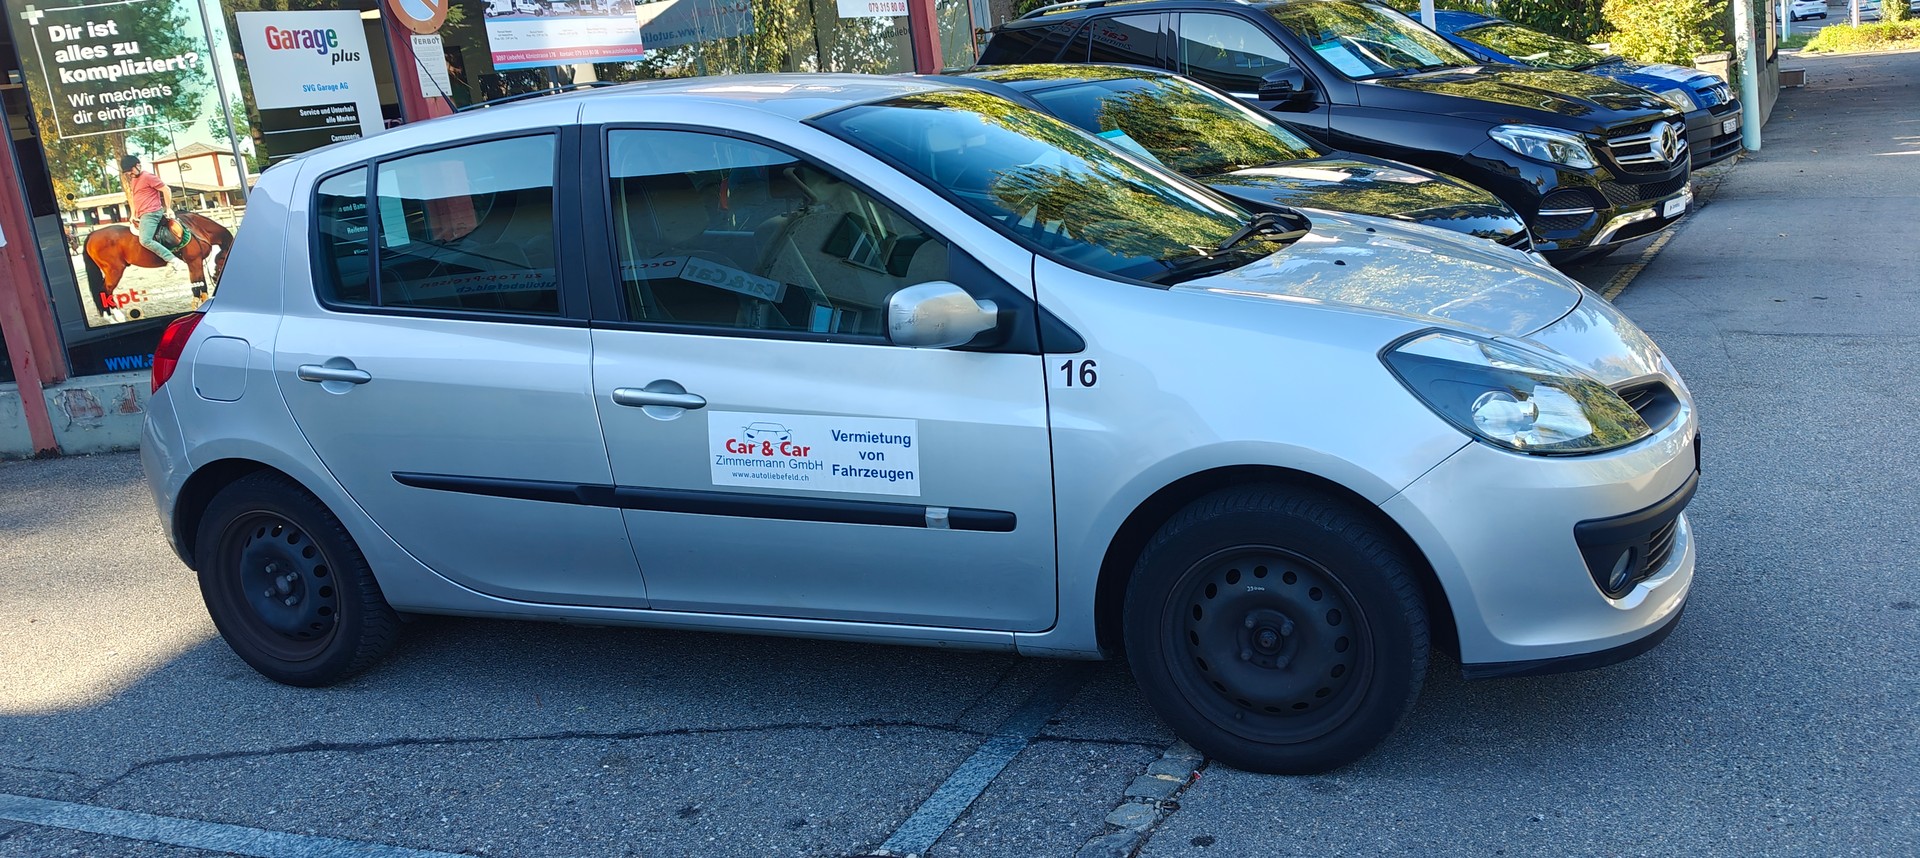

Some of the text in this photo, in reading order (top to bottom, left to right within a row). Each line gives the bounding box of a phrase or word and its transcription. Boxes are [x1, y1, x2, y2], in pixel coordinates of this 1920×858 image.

[868, 3, 879, 12] 079
[880, 2, 890, 12] 315
[48, 20, 119, 42] Dir ist
[265, 25, 338, 55] Garage
[413, 37, 440, 45] VERBOT
[54, 41, 140, 63] alles zu
[332, 49, 360, 65] plus
[59, 52, 199, 83] kompliziert?
[302, 82, 349, 92] SVG Garage AG
[68, 92, 95, 107] Wir
[73, 103, 158, 124] dir einfach.
[299, 108, 320, 116] Service
[331, 105, 355, 114] Unterhalt
[336, 115, 357, 123] Marken
[1060, 359, 1097, 387] 16
[831, 429, 911, 448] Vermietung
[726, 439, 810, 457] Car & Car
[859, 450, 885, 461] von
[716, 455, 823, 470] Zimmermann GmbH
[732, 471, 809, 482] www.autoliebefeld.ch
[832, 464, 914, 482] Fahrzeugen
